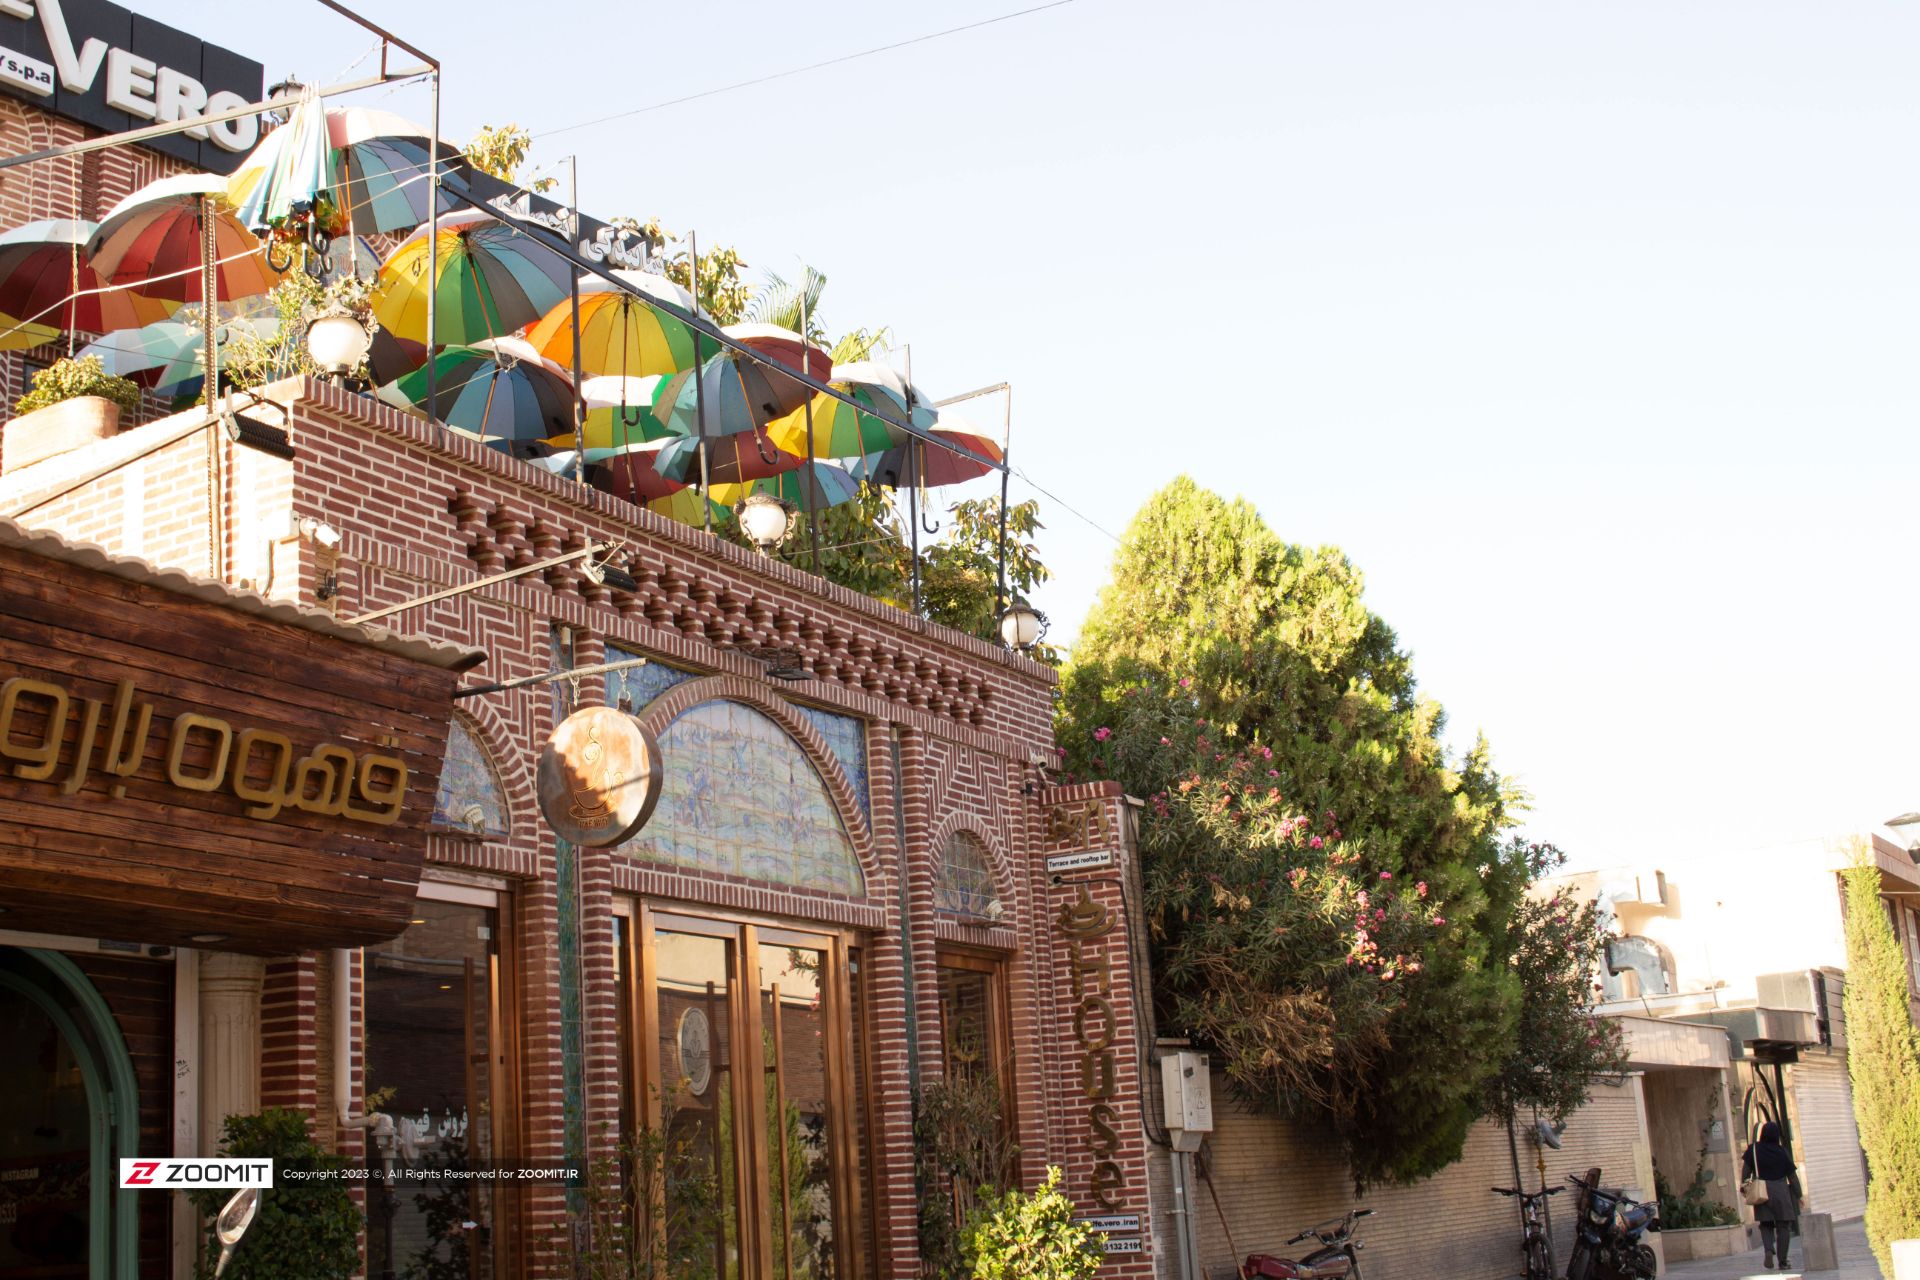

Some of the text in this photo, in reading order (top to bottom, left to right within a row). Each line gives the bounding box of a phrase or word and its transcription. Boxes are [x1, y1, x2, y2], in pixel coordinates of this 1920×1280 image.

[7, 59, 51, 85] s.p.a
[34, 0, 259, 153] VERO
[167, 712, 408, 826] قهوه
[1049, 860, 1069, 868] Terrace
[1081, 855, 1099, 863] rooftop
[438, 1105, 468, 1138] فروش
